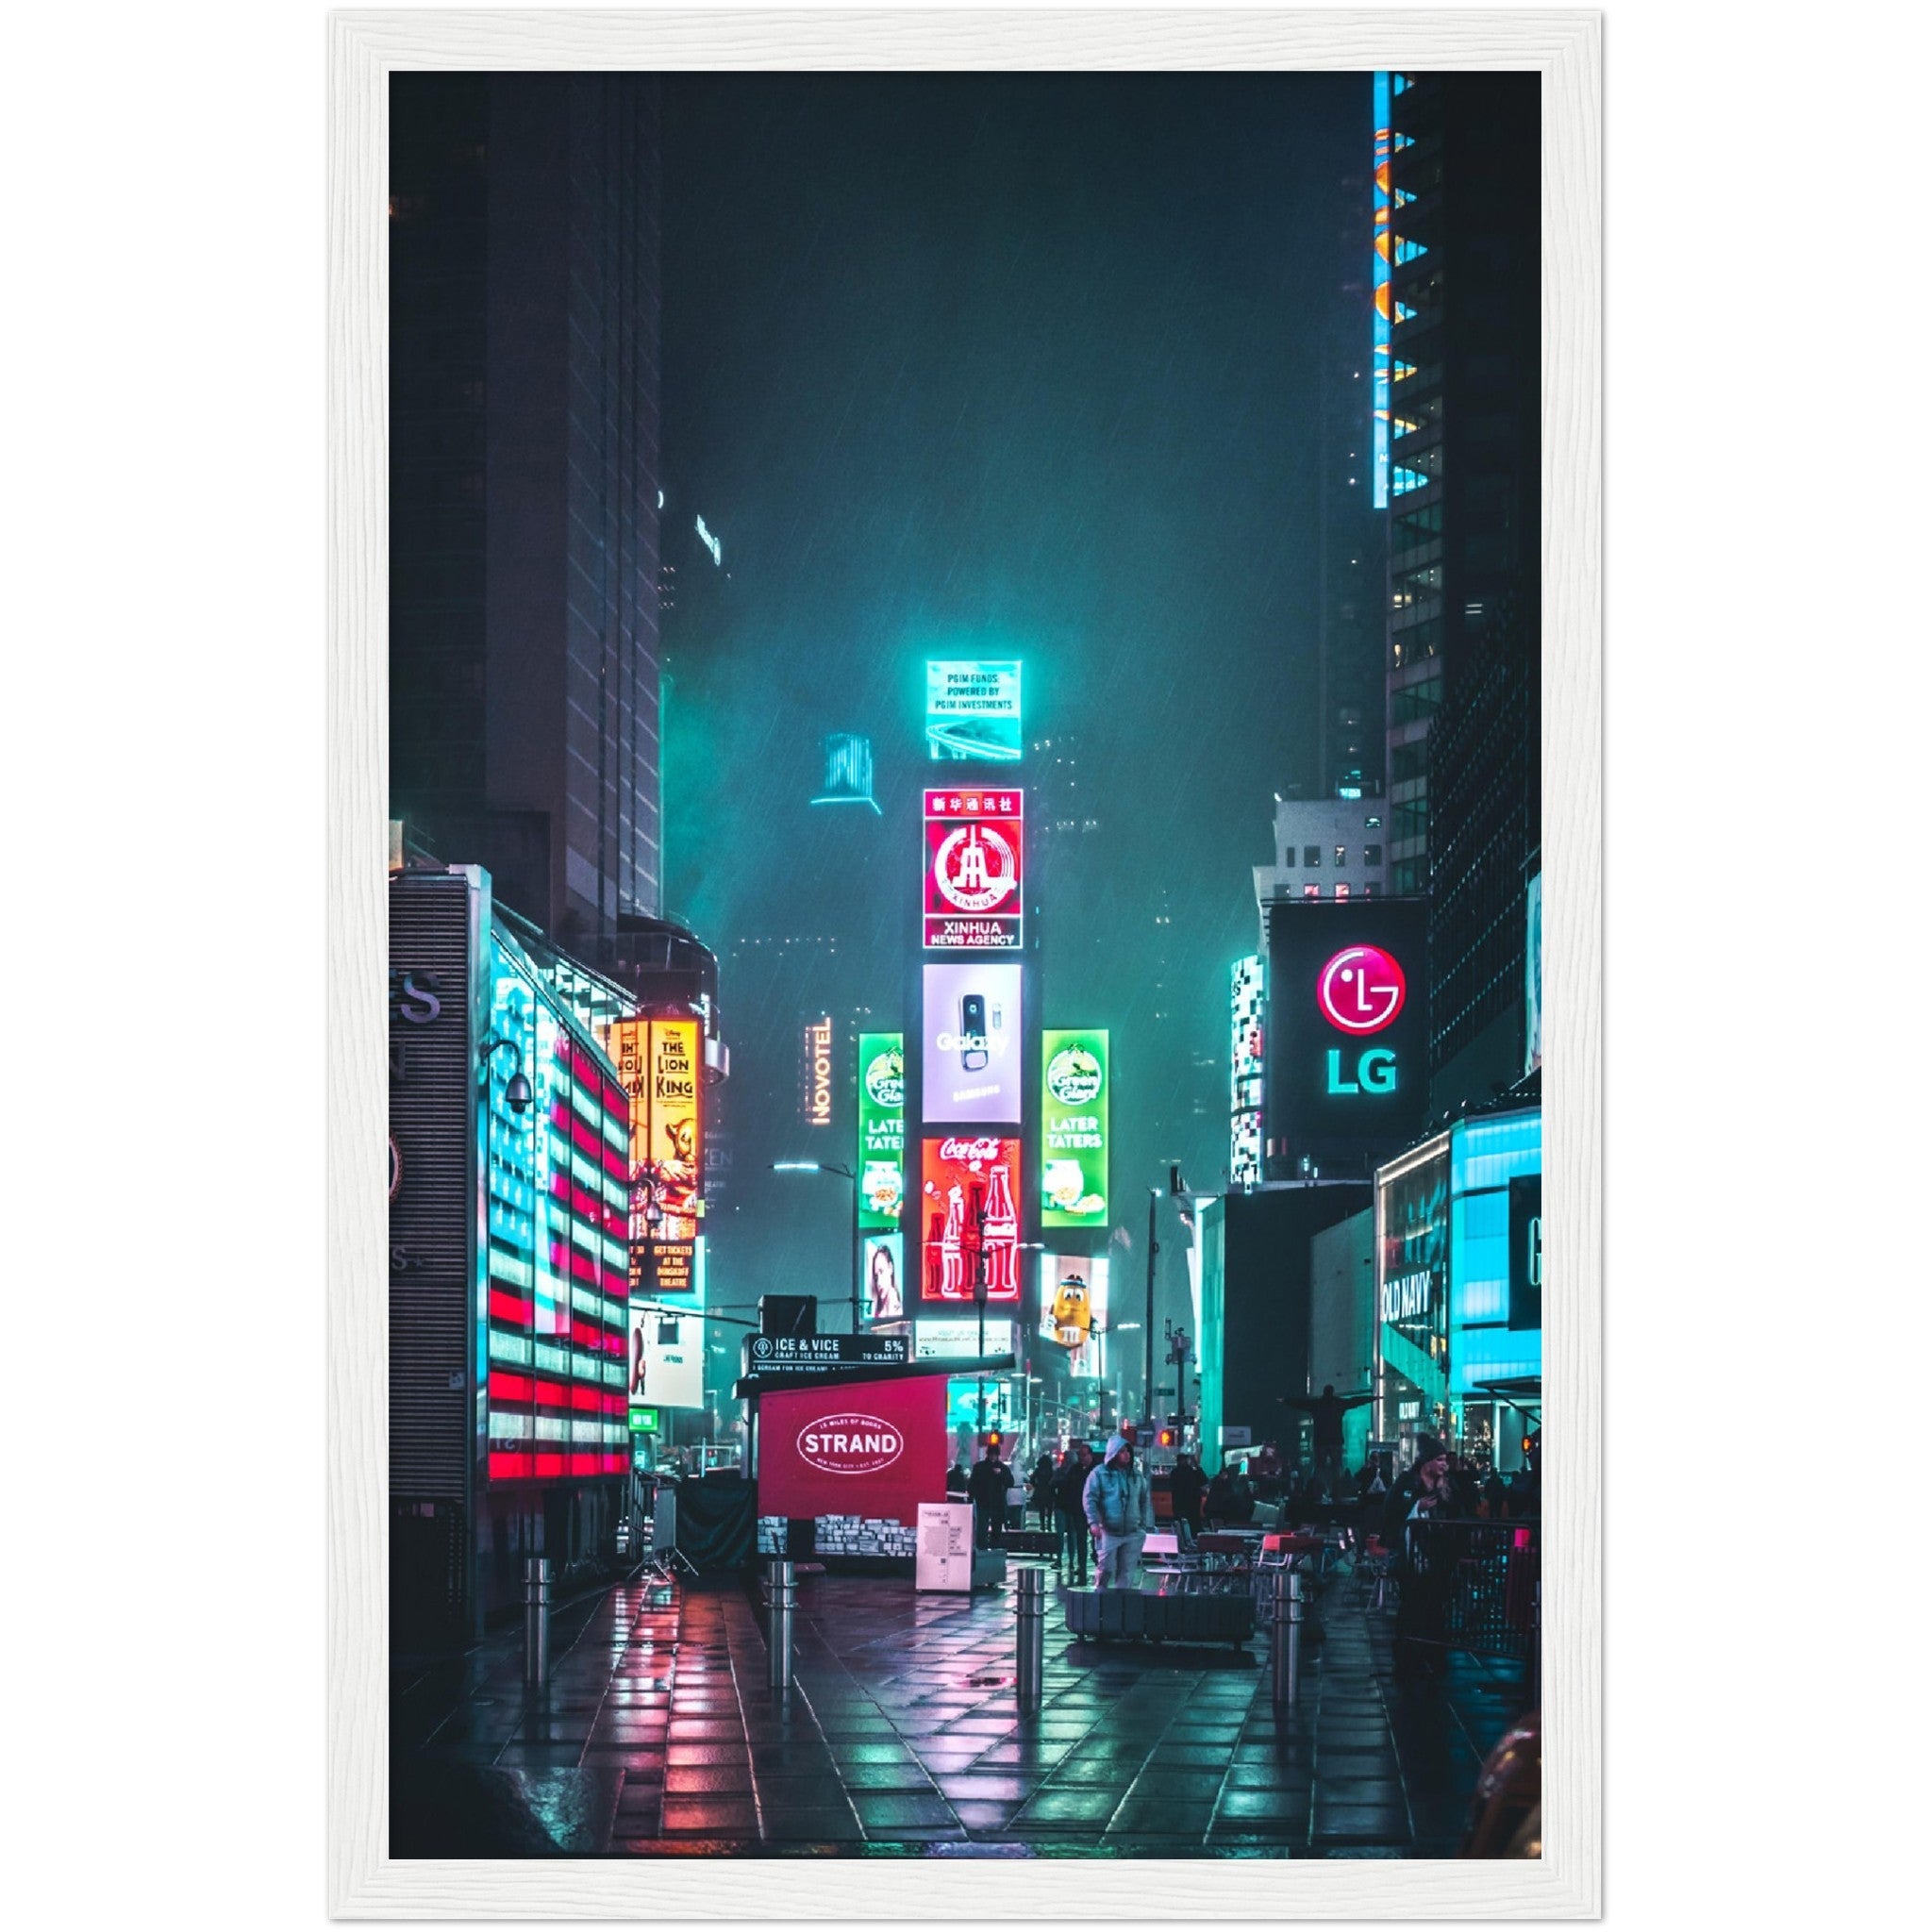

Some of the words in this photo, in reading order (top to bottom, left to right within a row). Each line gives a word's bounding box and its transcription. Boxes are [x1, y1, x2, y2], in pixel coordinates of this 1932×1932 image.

[947, 675, 969, 683] PGIM
[947, 687, 987, 696] POWERED
[989, 687, 1000, 696] BY
[935, 700, 957, 709] PGIM
[958, 700, 1012, 709] INVESTMENTS
[932, 797, 1012, 811] 新华通讯社
[952, 893, 998, 908] XINHUA
[944, 921, 1001, 934] XINHUA
[931, 935, 964, 945] NEWS
[966, 935, 1014, 945] AGENCY
[662, 1041, 684, 1053] THE
[936, 1031, 1009, 1056] Galaxy
[658, 1056, 689, 1074] LION
[812, 1017, 830, 1124] NOVOTEL
[1327, 1048, 1396, 1094] LG
[657, 1075, 692, 1098] KING
[1050, 1117, 1098, 1131] LATER
[865, 1136, 904, 1150] TATE
[1047, 1134, 1103, 1148] TATERS
[1381, 1280, 1401, 1323] OLD
[1402, 1271, 1430, 1318] NAVY
[775, 1338, 796, 1351] ICE
[799, 1338, 808, 1351] &
[811, 1339, 840, 1352] VICE
[884, 1340, 904, 1353] 5%
[874, 1353, 904, 1361] CHARITY
[805, 1434, 897, 1453] STRAND
